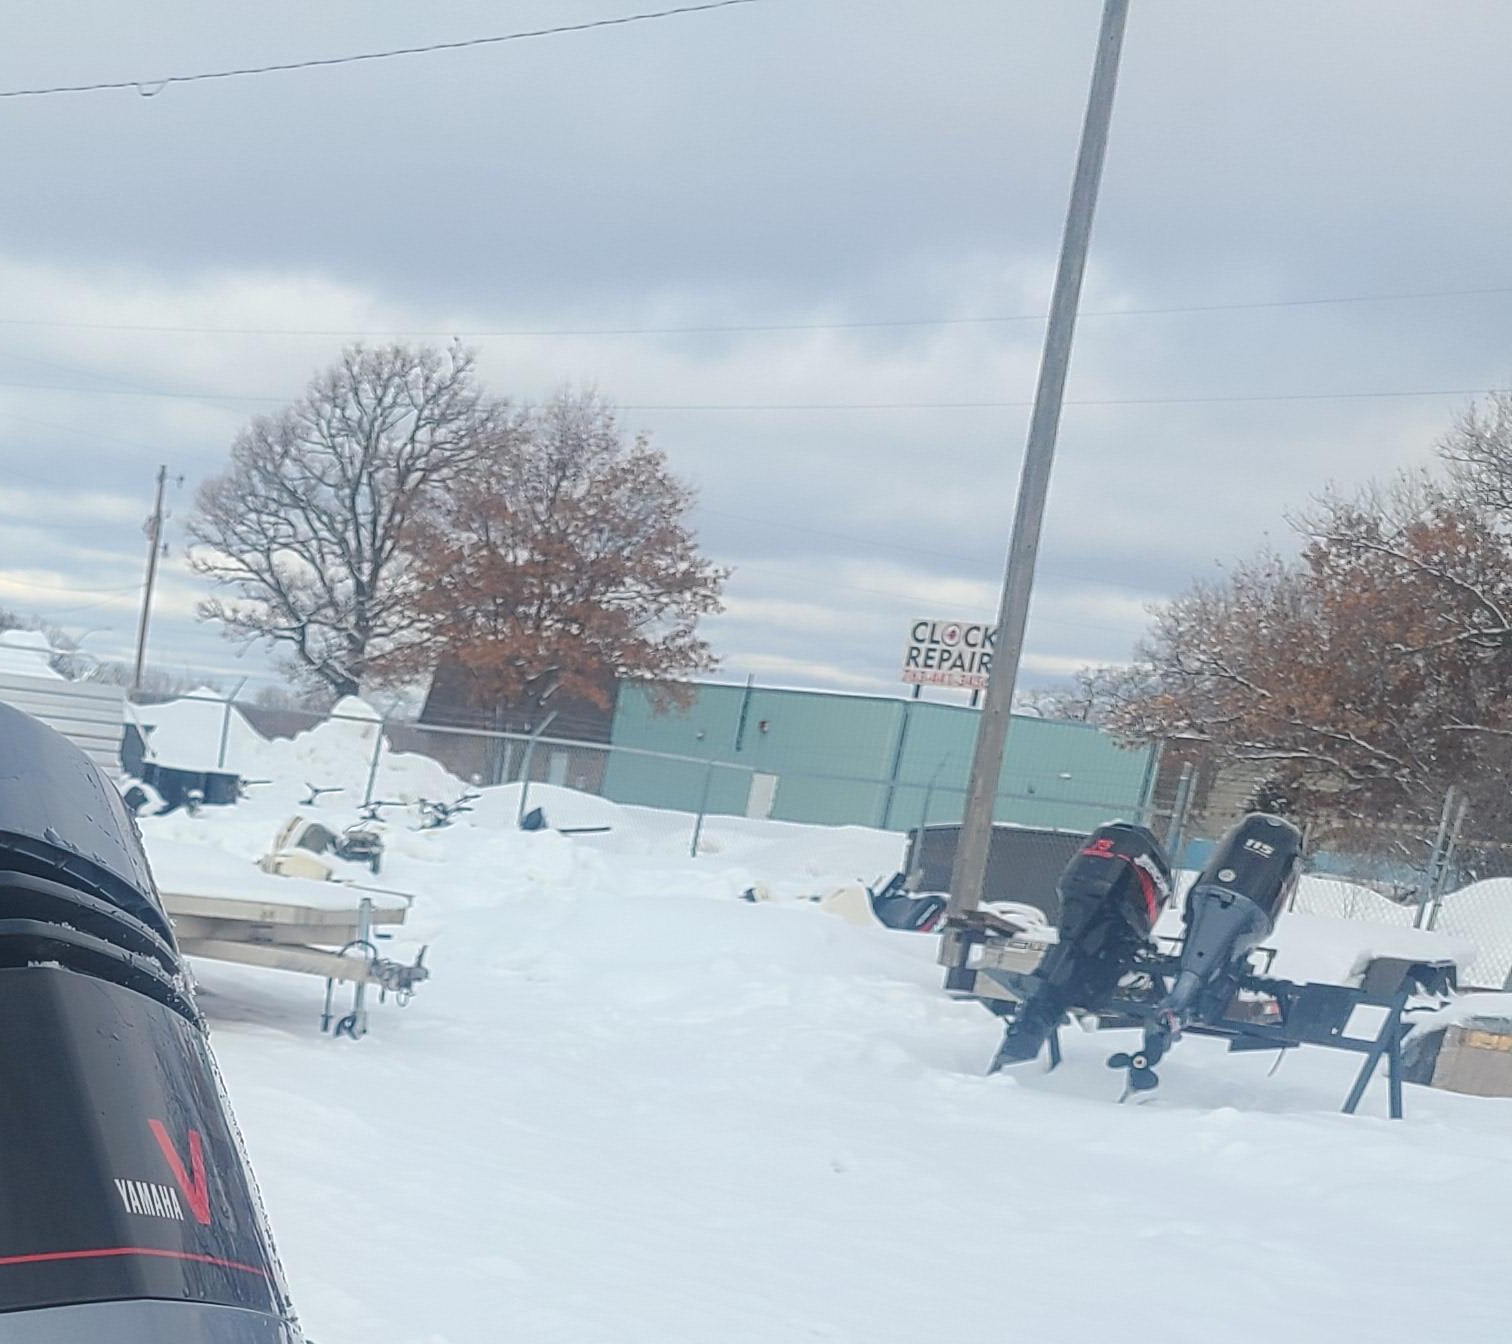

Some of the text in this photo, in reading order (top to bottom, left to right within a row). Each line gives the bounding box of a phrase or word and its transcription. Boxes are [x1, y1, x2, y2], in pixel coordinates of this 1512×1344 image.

[912, 621, 998, 648] CLOCK
[906, 646, 991, 673] REPAIR
[114, 1178, 185, 1221] YAMAHA
